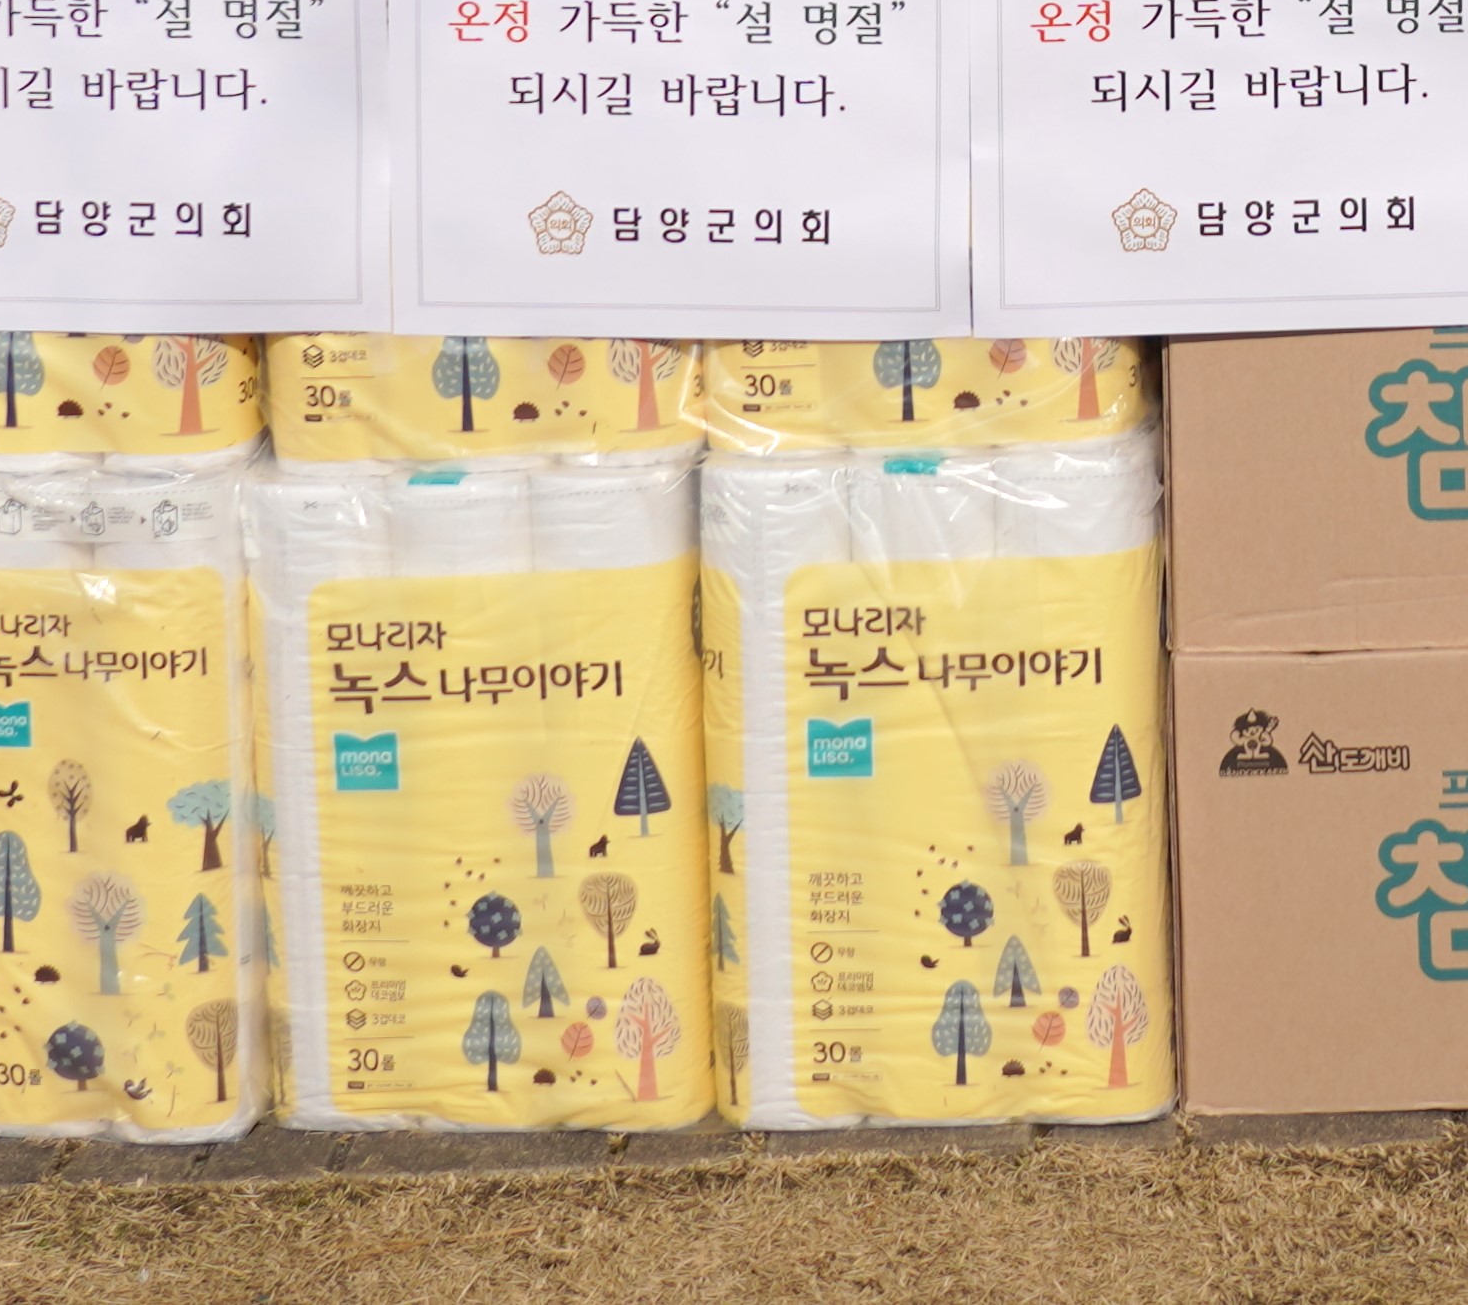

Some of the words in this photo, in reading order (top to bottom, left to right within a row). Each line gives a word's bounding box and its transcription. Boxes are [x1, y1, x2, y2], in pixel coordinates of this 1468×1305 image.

[448, 0, 529, 44] 온정
[559, 0, 689, 44] 가득한
[715, 0, 772, 45] “설
[803, 0, 906, 46] 명절”
[1030, 0, 1111, 43] 온정
[81, 68, 267, 111] 바랍니다.
[509, 72, 632, 116] 되시길
[661, 73, 846, 118] 바랍니다.
[1091, 68, 1216, 113] 되시길
[1245, 62, 1428, 109] 바랍니다.
[35, 200, 251, 238] 담양군의회
[613, 207, 830, 245] 담양군의회
[1132, 213, 1158, 230] 의회
[1197, 196, 1415, 237] 담양군의회
[327, 621, 447, 652] 모나리자
[802, 607, 925, 638] 모나리자
[63, 647, 207, 682] 나무이야기
[803, 646, 910, 702] 녹스
[917, 647, 1102, 692] 나무이야기
[328, 661, 432, 715] 녹스
[439, 660, 623, 706] 나무이야기
[340, 749, 393, 763] mona
[813, 736, 868, 750] mona
[1297, 731, 1411, 775] 산도깨비
[810, 873, 863, 886] 깨끗하고
[810, 892, 863, 904] 부드러운
[811, 910, 850, 923] 화장지
[348, 1049, 395, 1071] 30롤
[813, 1042, 863, 1063] 30롤
